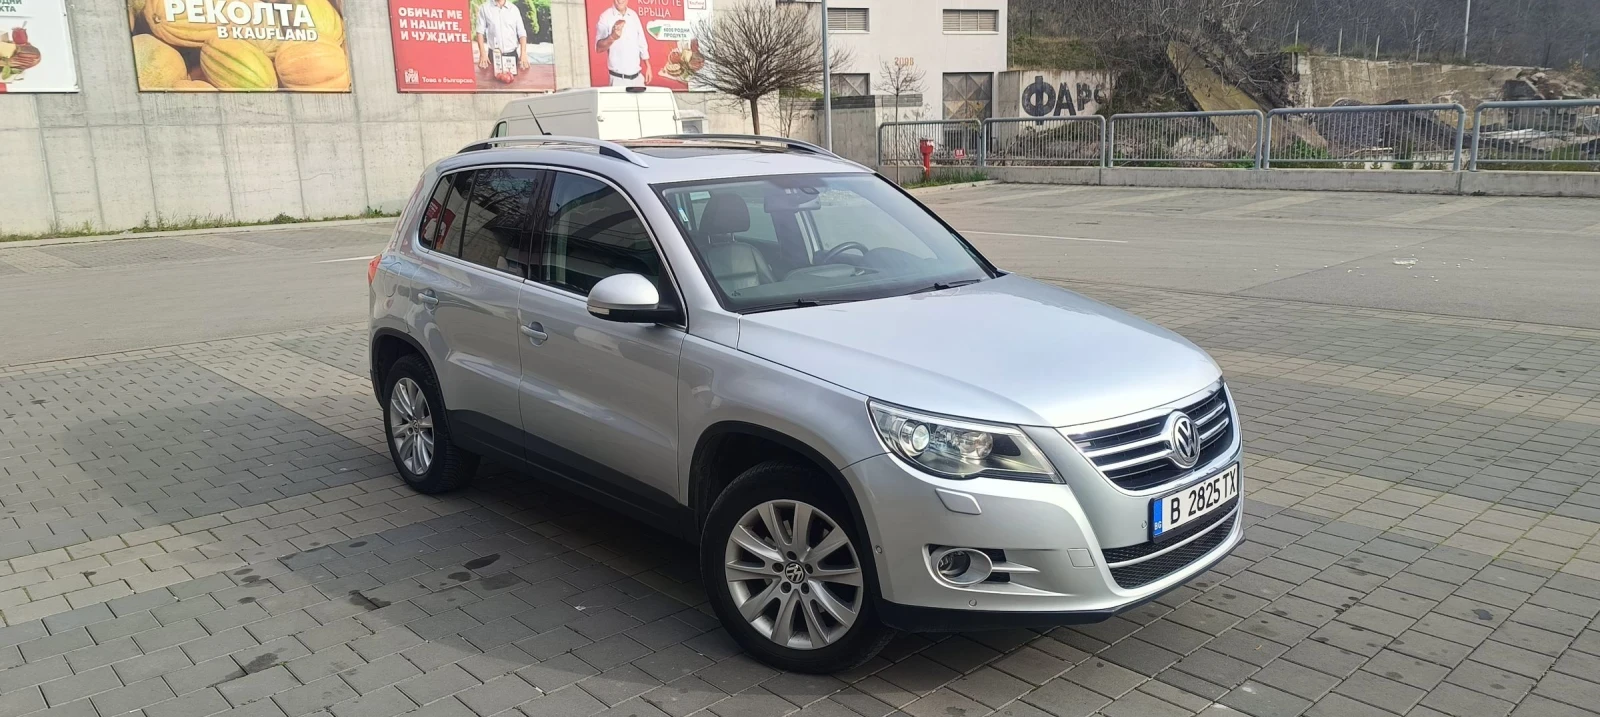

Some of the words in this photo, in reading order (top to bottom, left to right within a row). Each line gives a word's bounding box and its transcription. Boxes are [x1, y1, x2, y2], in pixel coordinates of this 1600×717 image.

[165, 0, 315, 27] РЕКОЛТА
[398, 7, 444, 19] ОБИЧАТ
[447, 10, 463, 20] МЕ
[638, 7, 671, 18] ВРЪЩА
[400, 19, 408, 28] И
[410, 20, 462, 32] НАШИТЕ,
[218, 26, 229, 39] В
[232, 27, 318, 41] KAUFLAND
[401, 31, 409, 40] И
[411, 31, 471, 44] ЧУЖДИТЕ.
[1170, 497, 1181, 525] B
[1188, 480, 1221, 516] 2825
[1222, 468, 1237, 497] TX
[1154, 521, 1162, 531] BG
